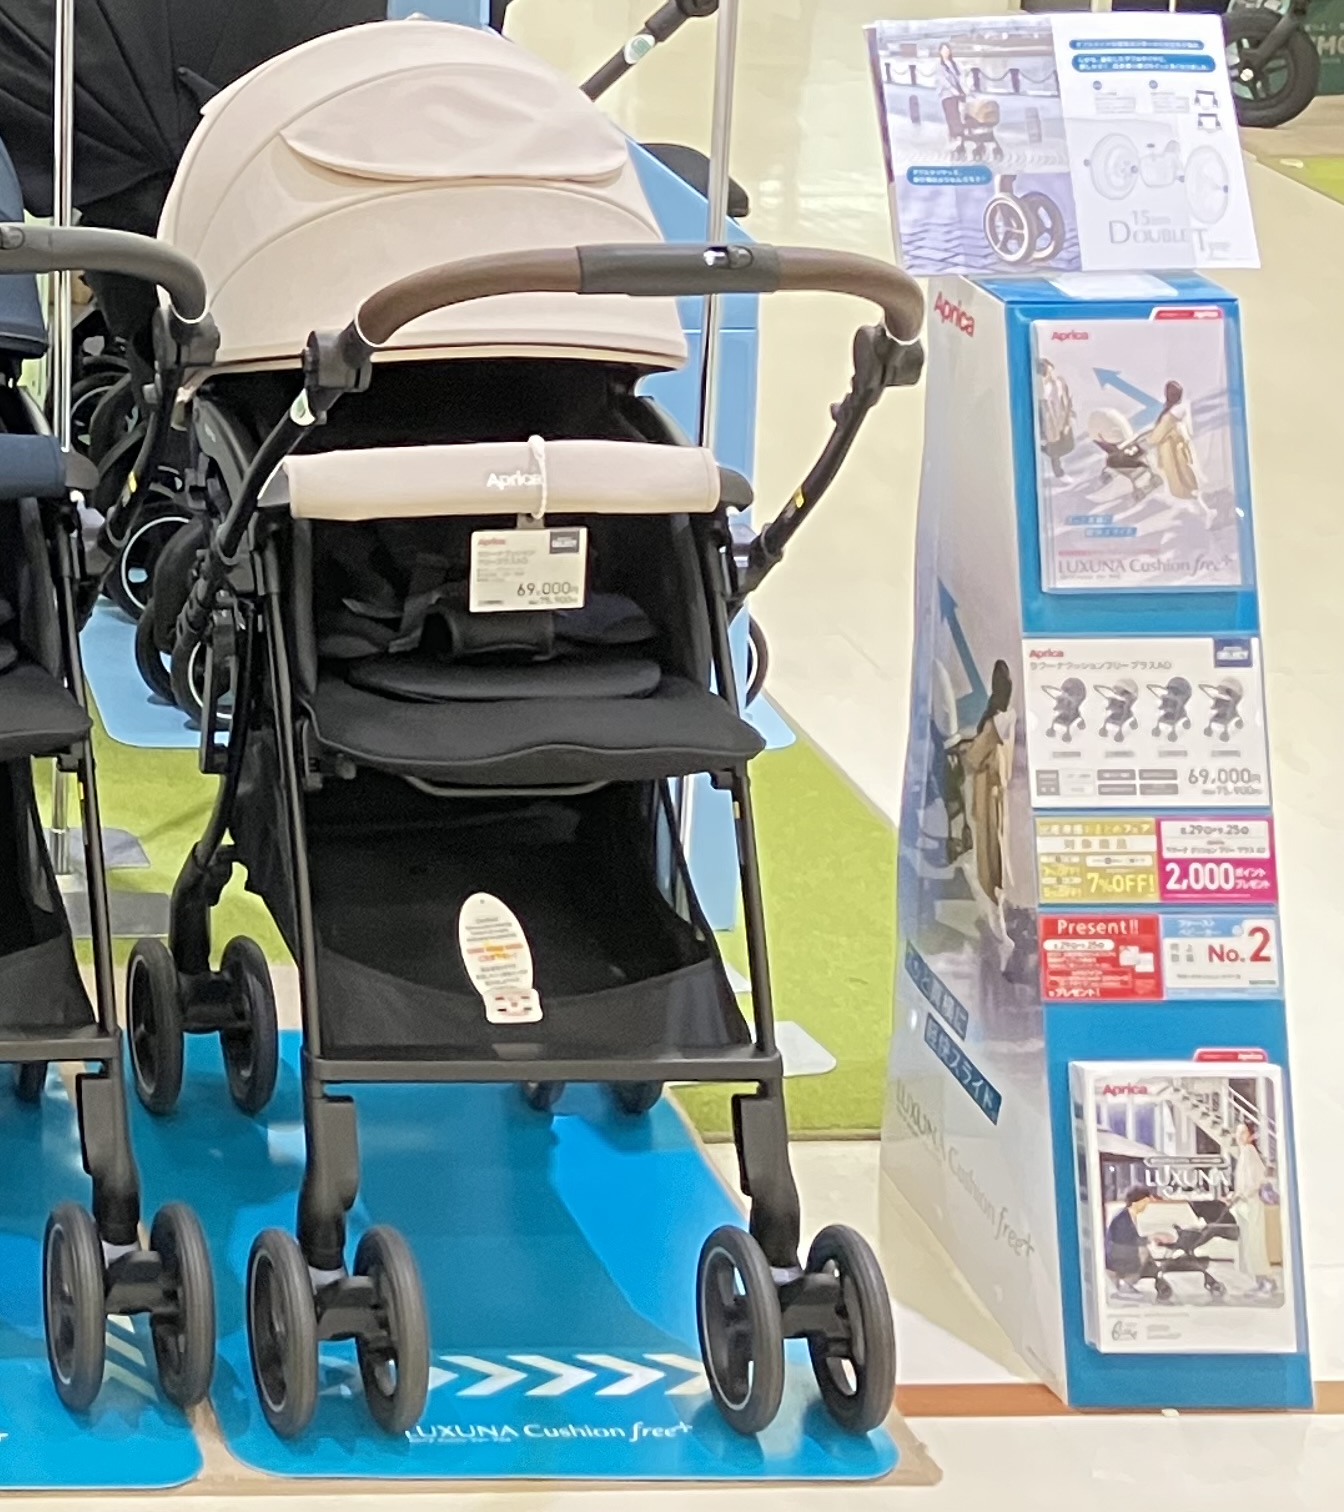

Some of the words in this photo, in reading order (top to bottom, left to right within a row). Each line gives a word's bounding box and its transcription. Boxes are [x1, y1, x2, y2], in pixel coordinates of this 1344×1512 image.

[933, 290, 976, 337] Aprica
[1051, 329, 1089, 342] Aprica
[486, 470, 544, 491] Aprica
[1058, 558, 1125, 574] LUXUNA
[1129, 558, 1190, 573] Cushion
[1165, 862, 1235, 891] 2,000
[1103, 1082, 1148, 1096] Aprica
[1144, 1165, 1230, 1188] LUXUNA
[523, 1422, 626, 1440] Cushion
